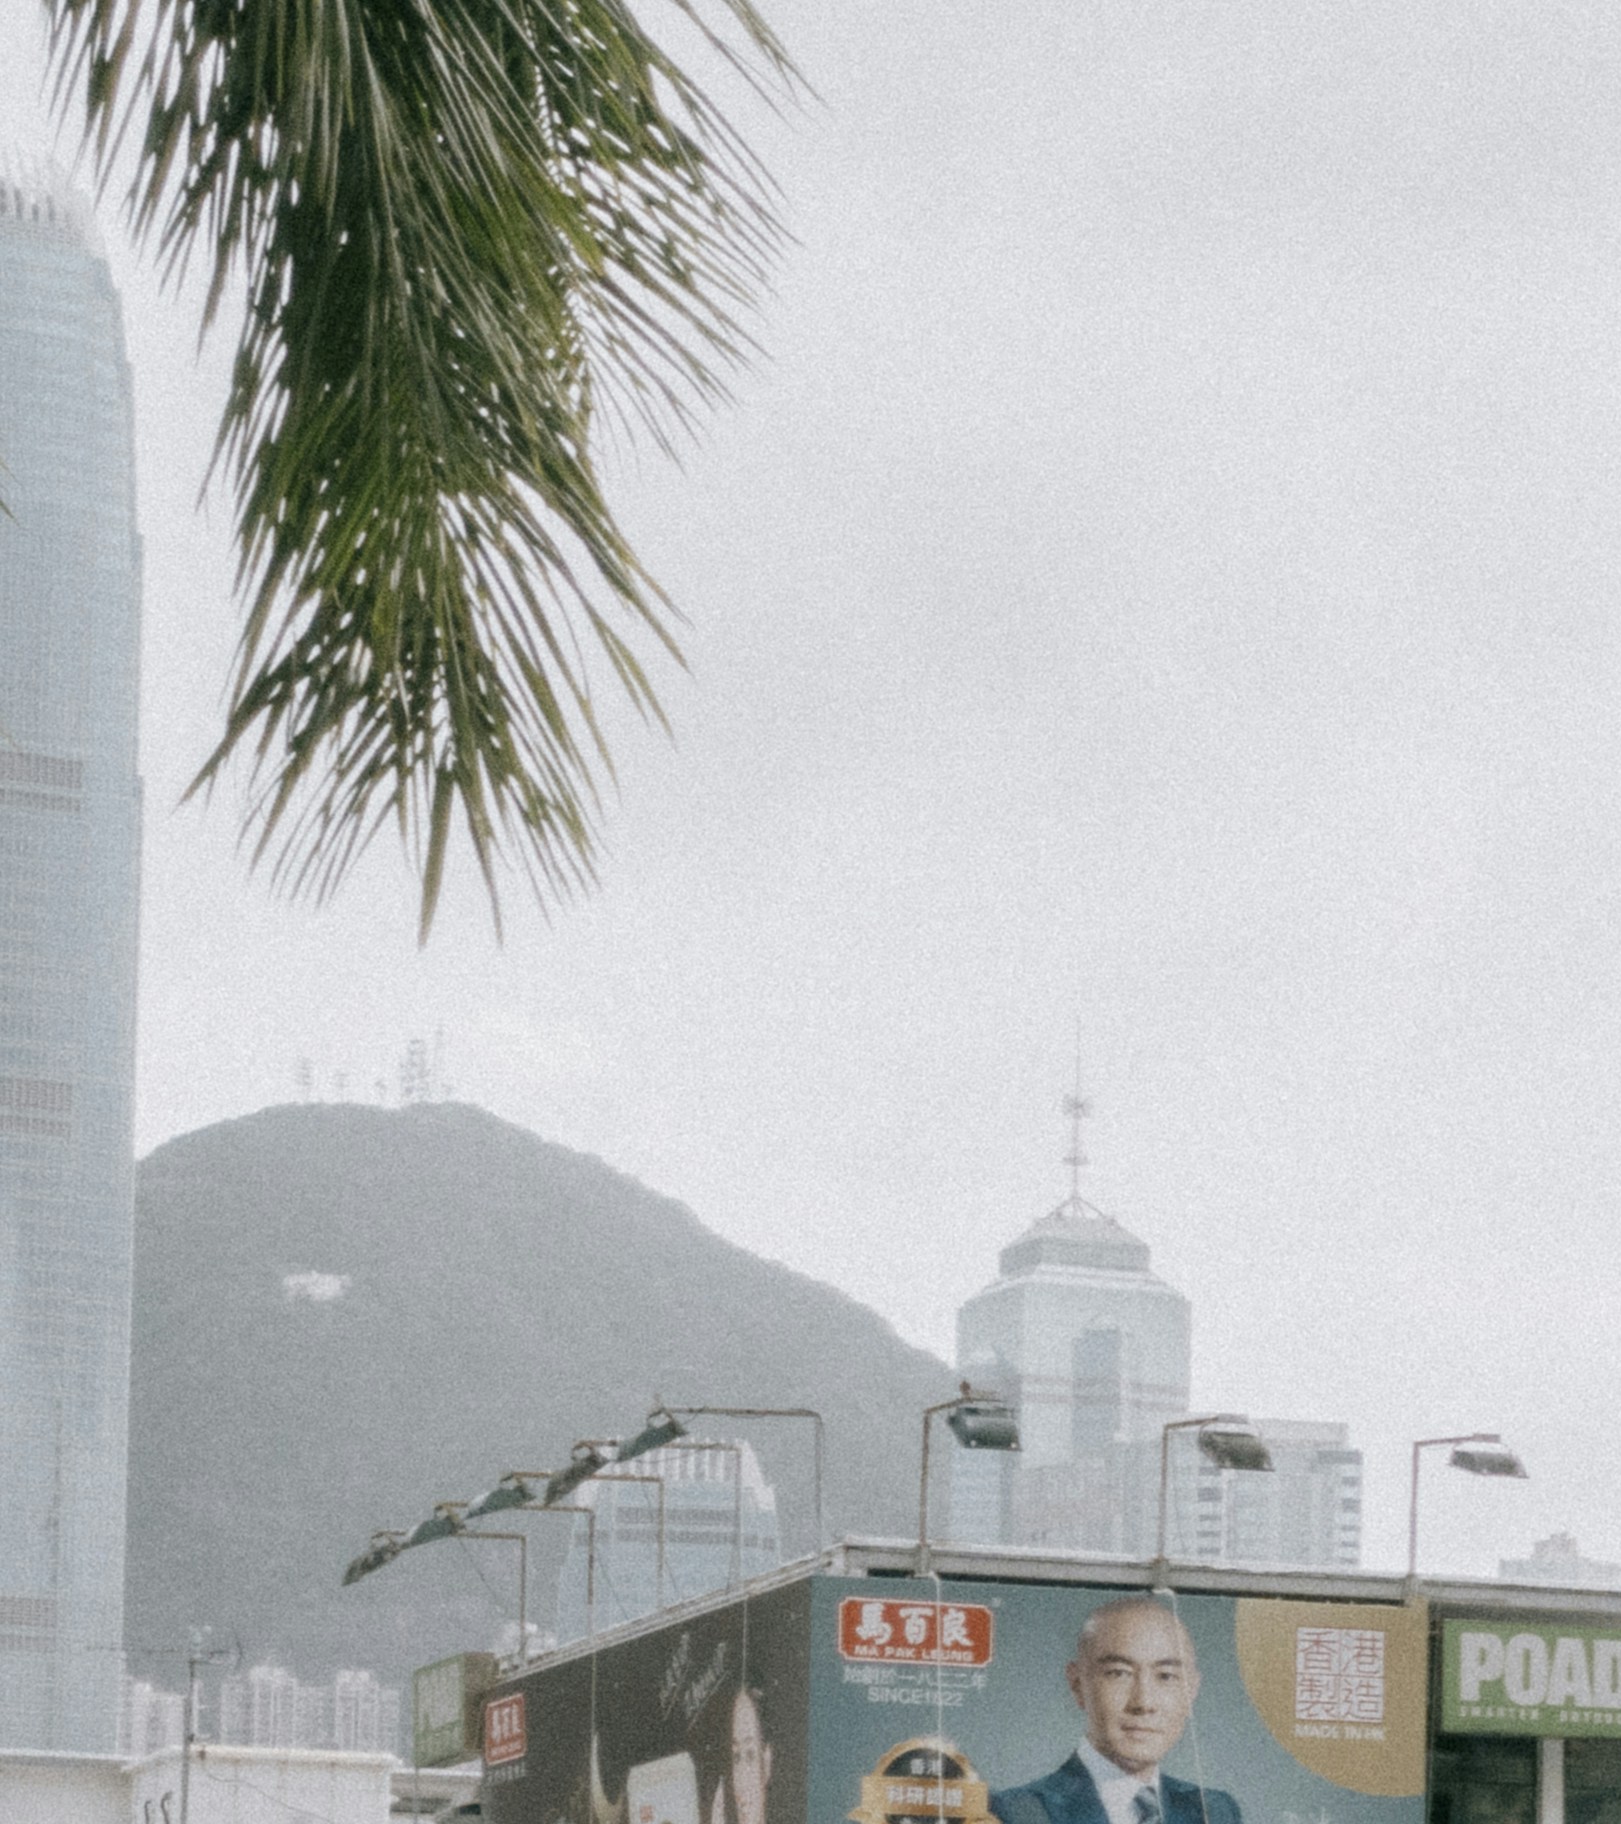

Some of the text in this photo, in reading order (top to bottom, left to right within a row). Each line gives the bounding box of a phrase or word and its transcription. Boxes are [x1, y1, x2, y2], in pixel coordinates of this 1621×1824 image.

[856, 1603, 974, 1646] 馬百良
[855, 1645, 974, 1663] MA PAK LEUNG
[1296, 1725, 1339, 1740] MADE
[1345, 1726, 1362, 1740] IN
